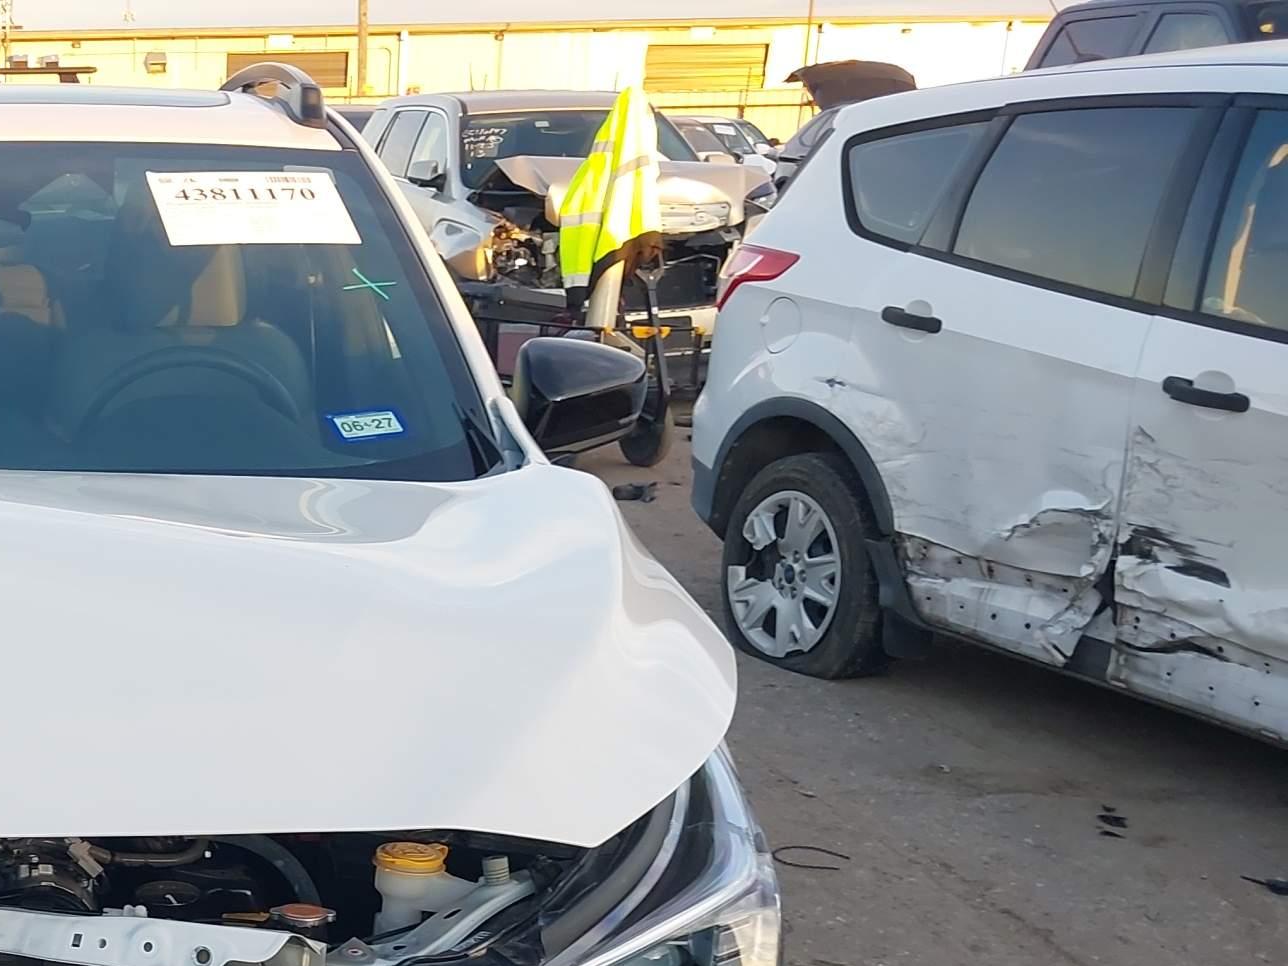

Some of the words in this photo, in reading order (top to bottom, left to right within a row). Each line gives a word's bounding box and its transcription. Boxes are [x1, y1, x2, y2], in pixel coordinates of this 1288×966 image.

[175, 188, 316, 201] 43811170
[340, 420, 364, 433] 06
[371, 417, 393, 429] 27
